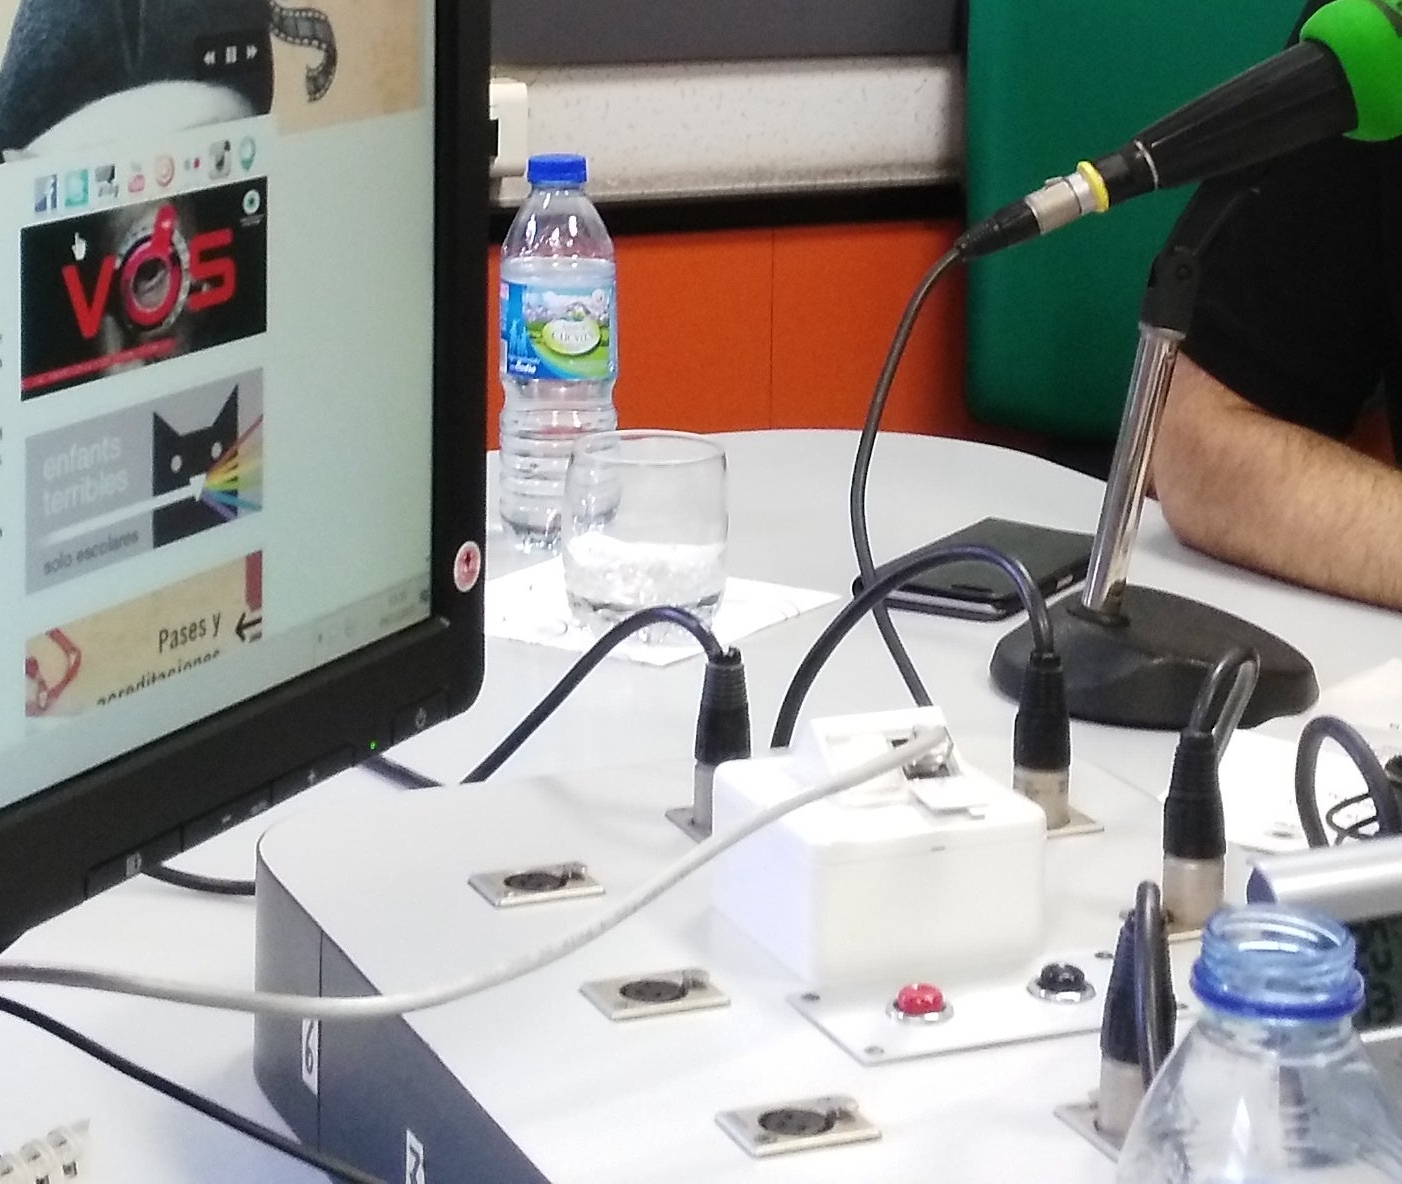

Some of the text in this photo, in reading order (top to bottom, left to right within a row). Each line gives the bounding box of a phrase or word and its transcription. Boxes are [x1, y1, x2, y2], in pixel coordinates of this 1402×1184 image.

[61, 227, 237, 340] VOS
[158, 618, 206, 653] Pases
[212, 611, 221, 637] y
